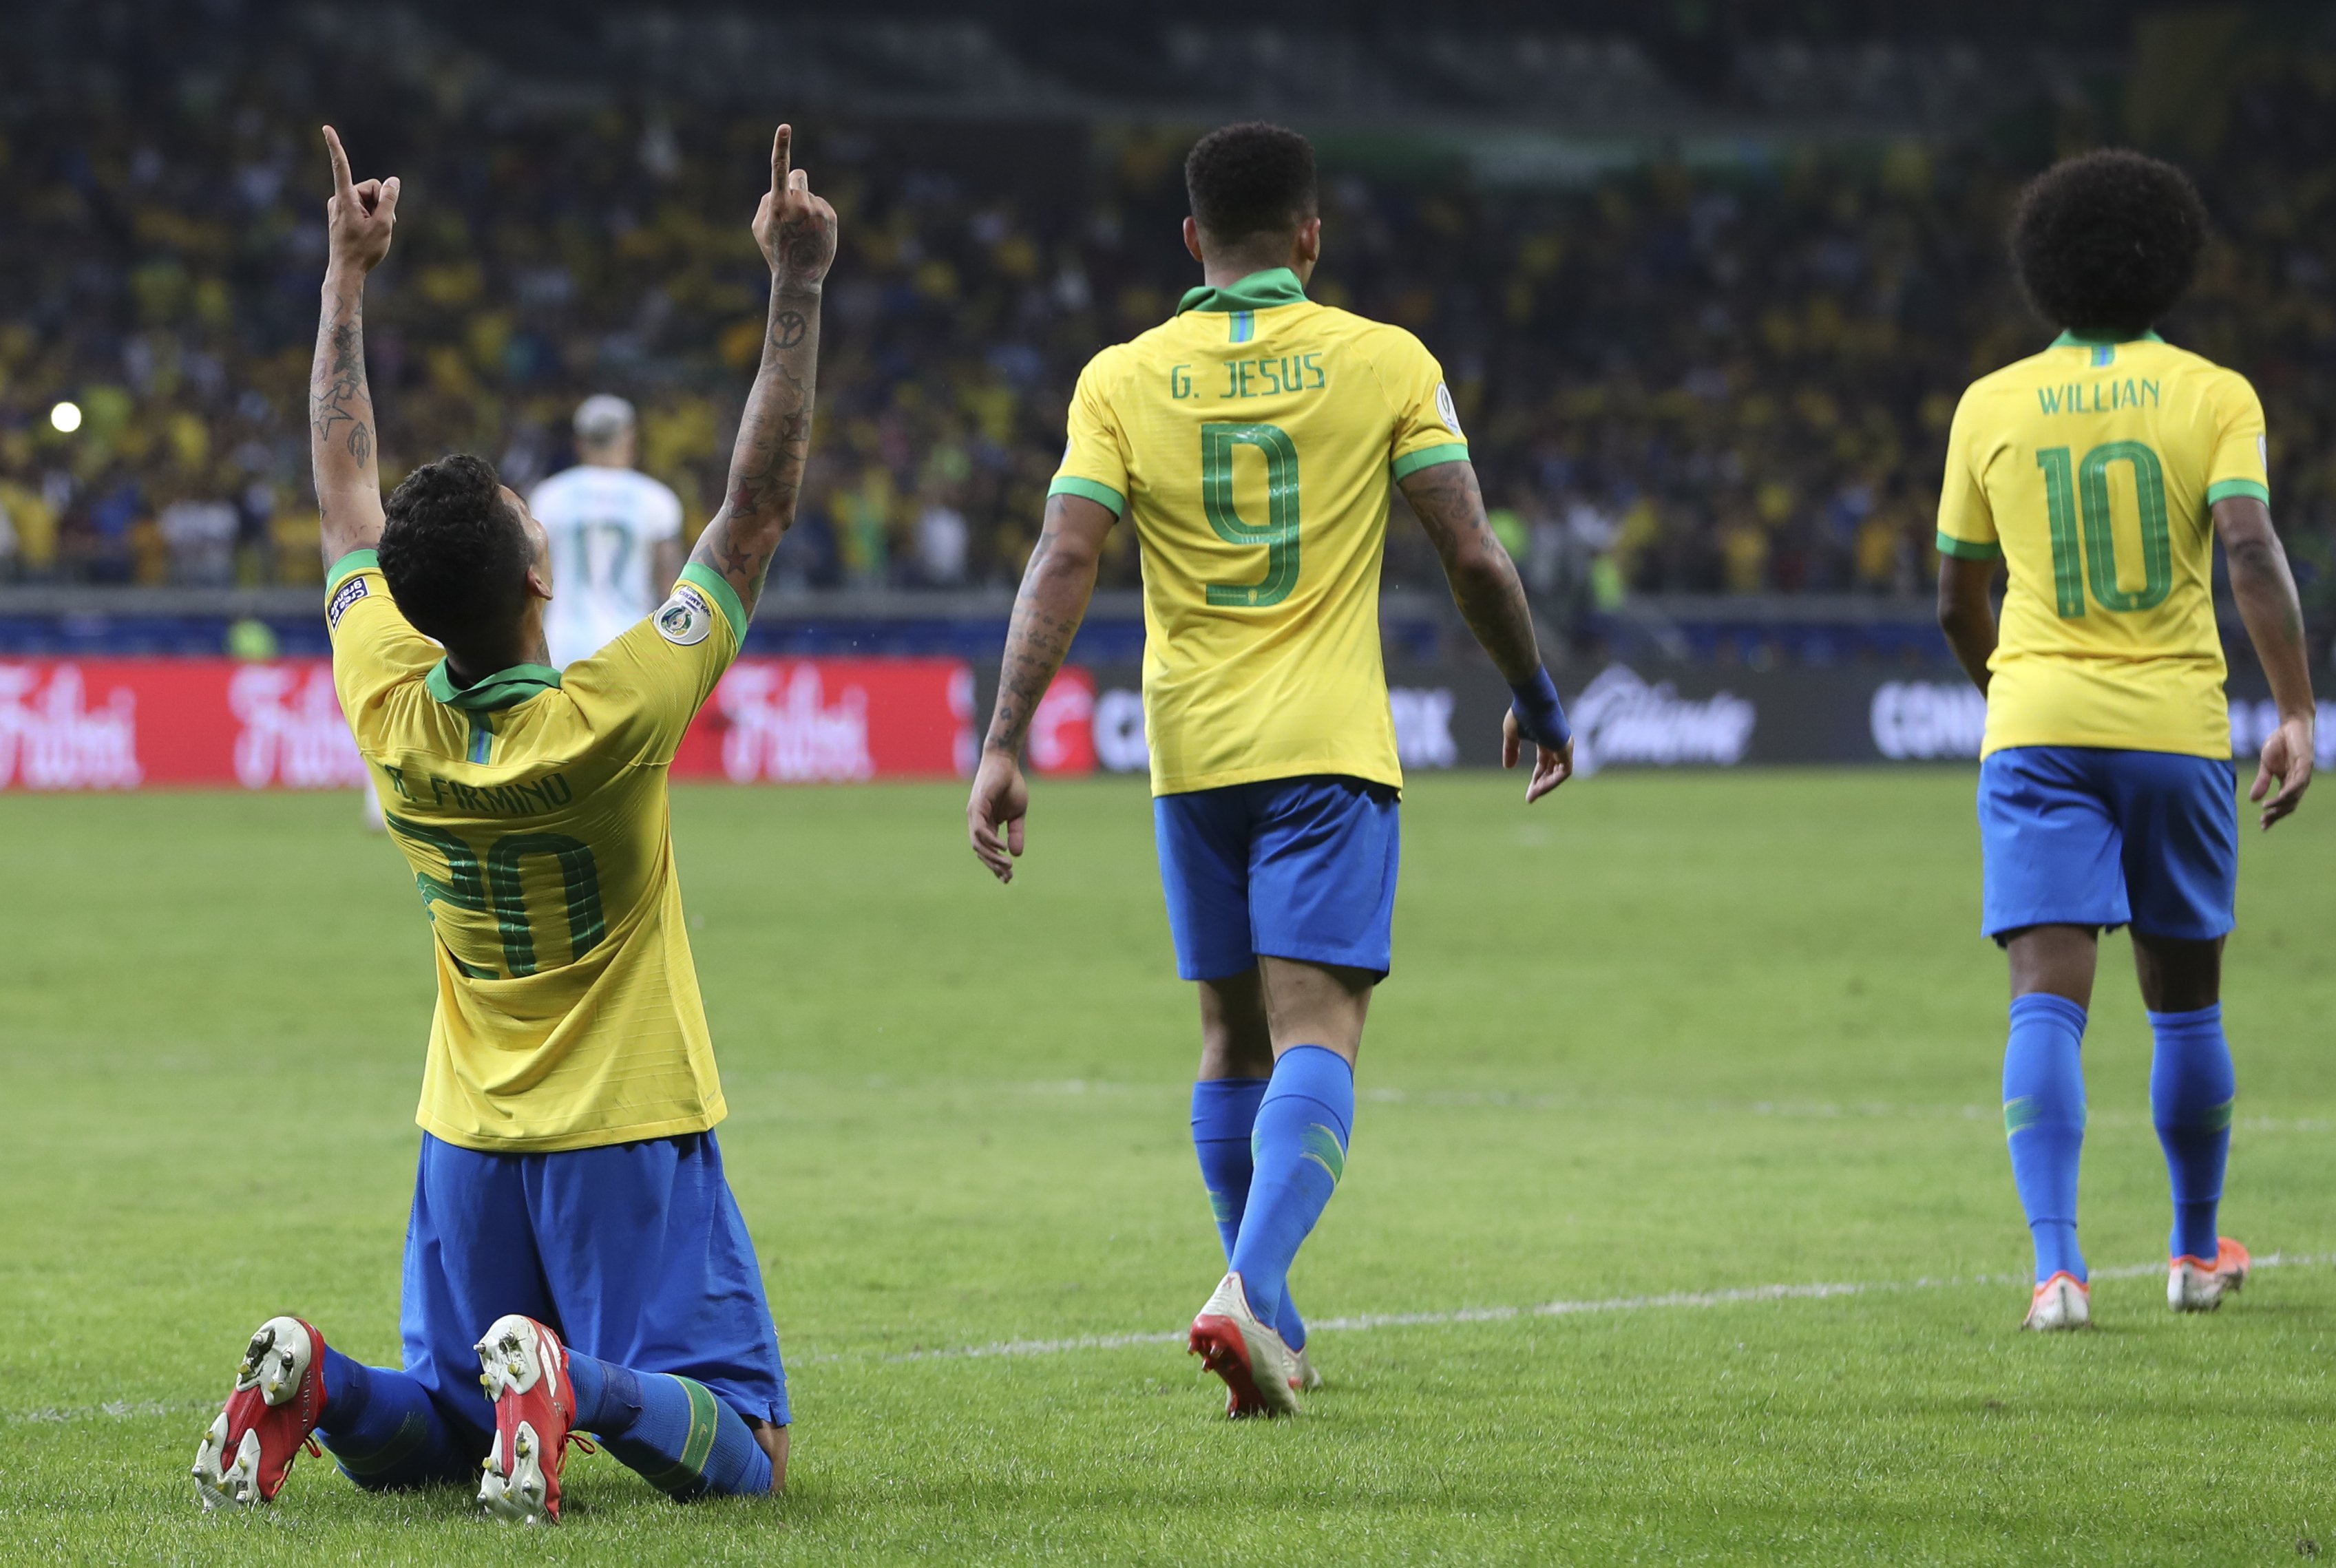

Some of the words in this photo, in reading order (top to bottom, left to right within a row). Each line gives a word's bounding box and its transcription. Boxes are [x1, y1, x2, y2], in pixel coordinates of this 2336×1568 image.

[1171, 365, 1199, 399] G.
[1220, 352, 1325, 400] JESUS
[2037, 379, 2160, 414] WILLIAN
[1201, 423, 1299, 606] 9
[2036, 440, 2172, 618] 10
[330, 580, 362, 615] grande
[384, 764, 417, 803] R.
[430, 772, 573, 815] FIRMINO
[386, 808, 607, 980] 20
